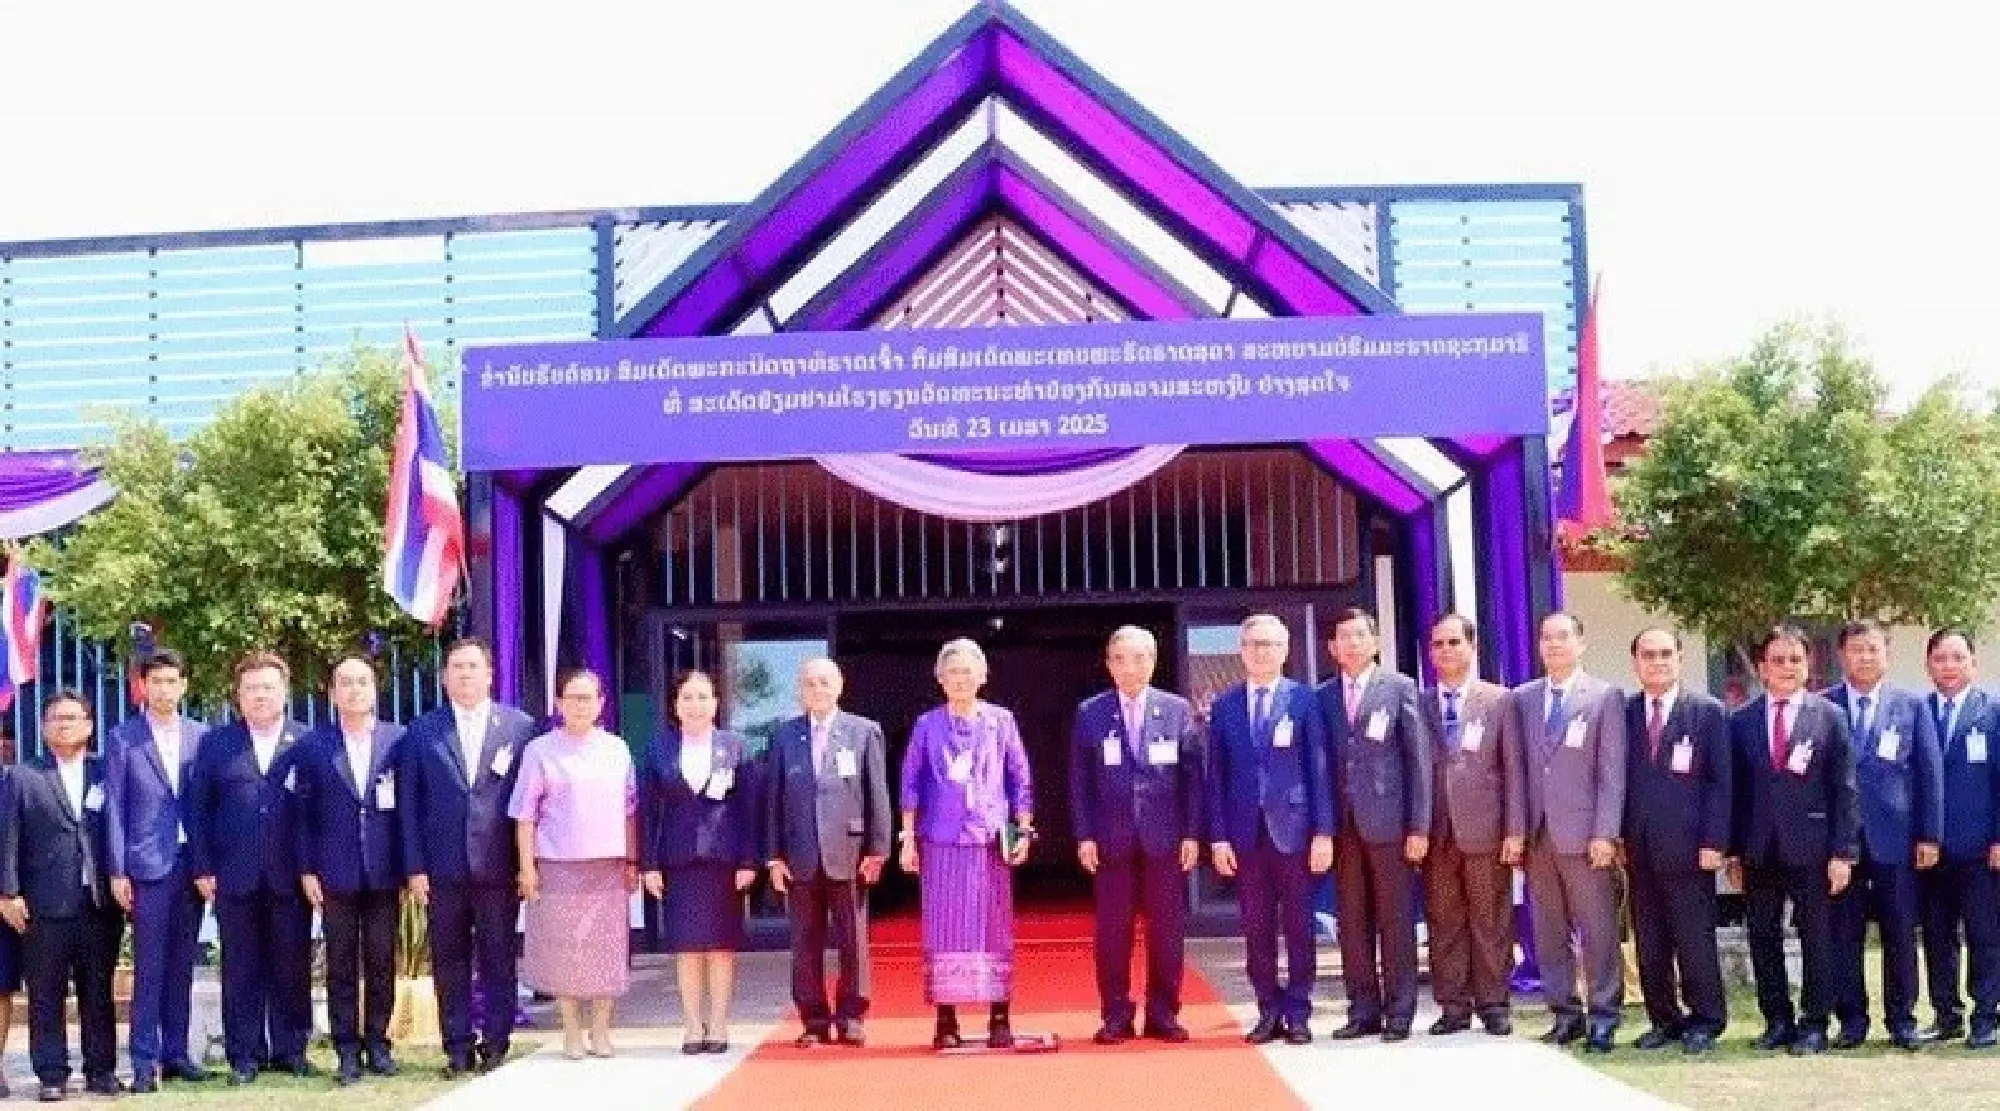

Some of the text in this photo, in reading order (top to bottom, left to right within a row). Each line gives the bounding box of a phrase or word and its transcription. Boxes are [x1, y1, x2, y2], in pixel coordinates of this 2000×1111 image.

[966, 417, 992, 438] 23
[999, 418, 1051, 437] ເມສາ
[1057, 413, 1109, 436] 2025
